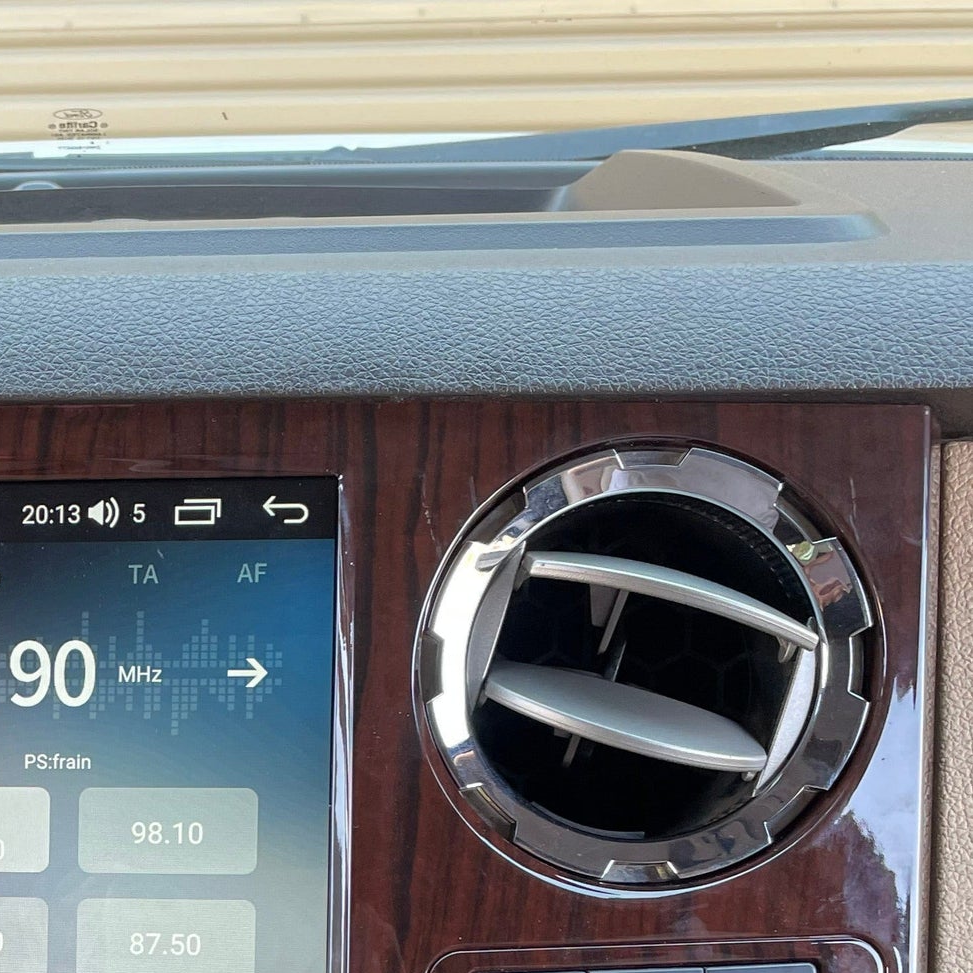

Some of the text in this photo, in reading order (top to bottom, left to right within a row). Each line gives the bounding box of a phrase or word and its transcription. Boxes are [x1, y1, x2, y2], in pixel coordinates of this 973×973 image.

[22, 504, 81, 526] 20:13
[132, 503, 146, 524] 5
[128, 565, 159, 584] TA
[237, 563, 267, 583] AF
[118, 666, 163, 684] MHz
[24, 753, 92, 771] PS:frain
[131, 821, 204, 846] 98.10
[129, 933, 202, 957] 87.50
